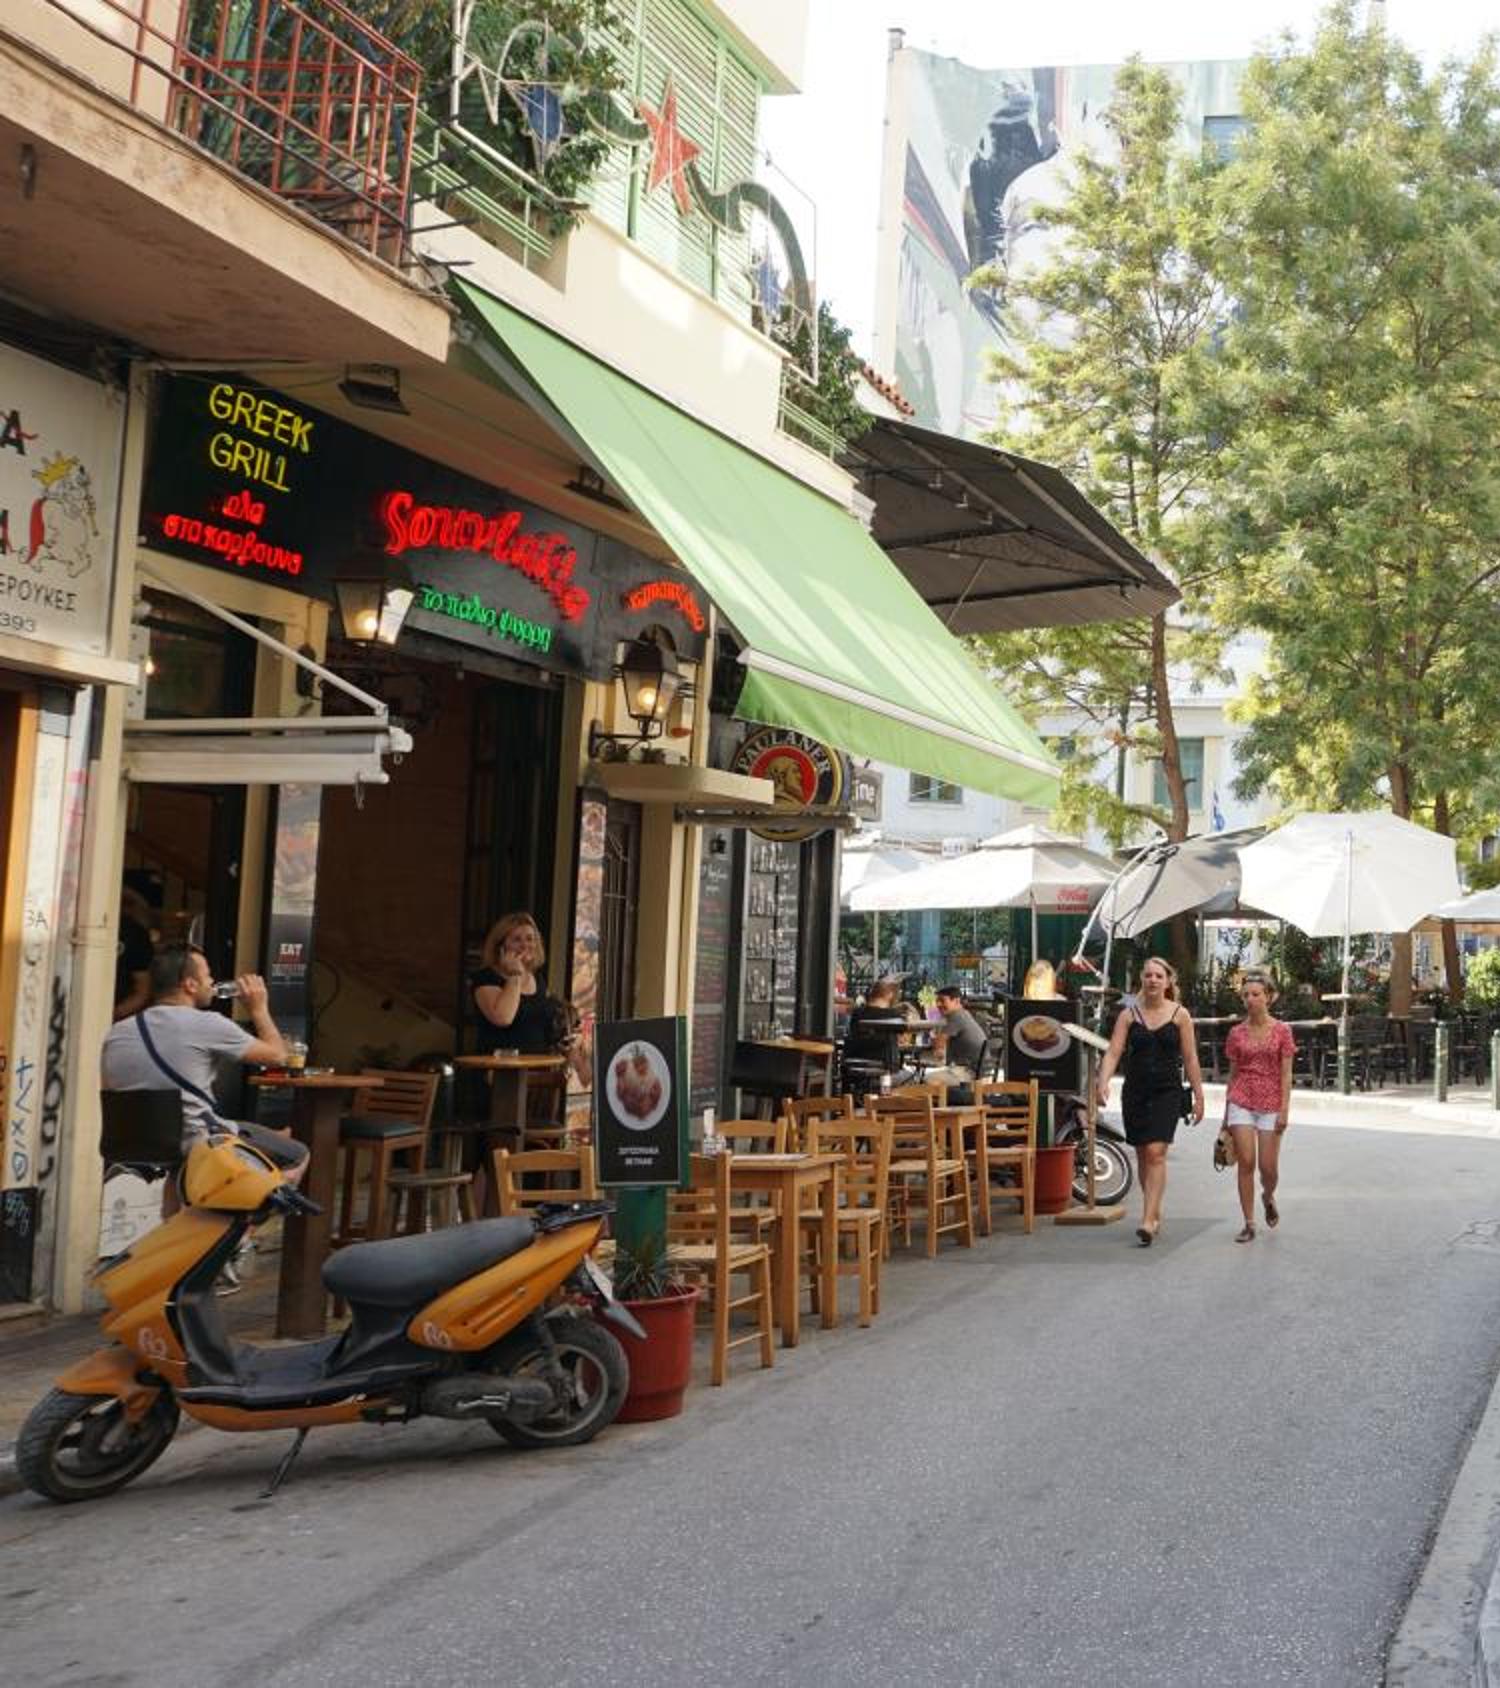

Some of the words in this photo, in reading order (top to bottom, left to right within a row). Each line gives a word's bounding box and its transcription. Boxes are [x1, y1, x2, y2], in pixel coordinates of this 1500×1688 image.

[208, 383, 315, 454] GREEK
[209, 432, 290, 493] GRILL
[737, 730, 831, 775] PAULANER
